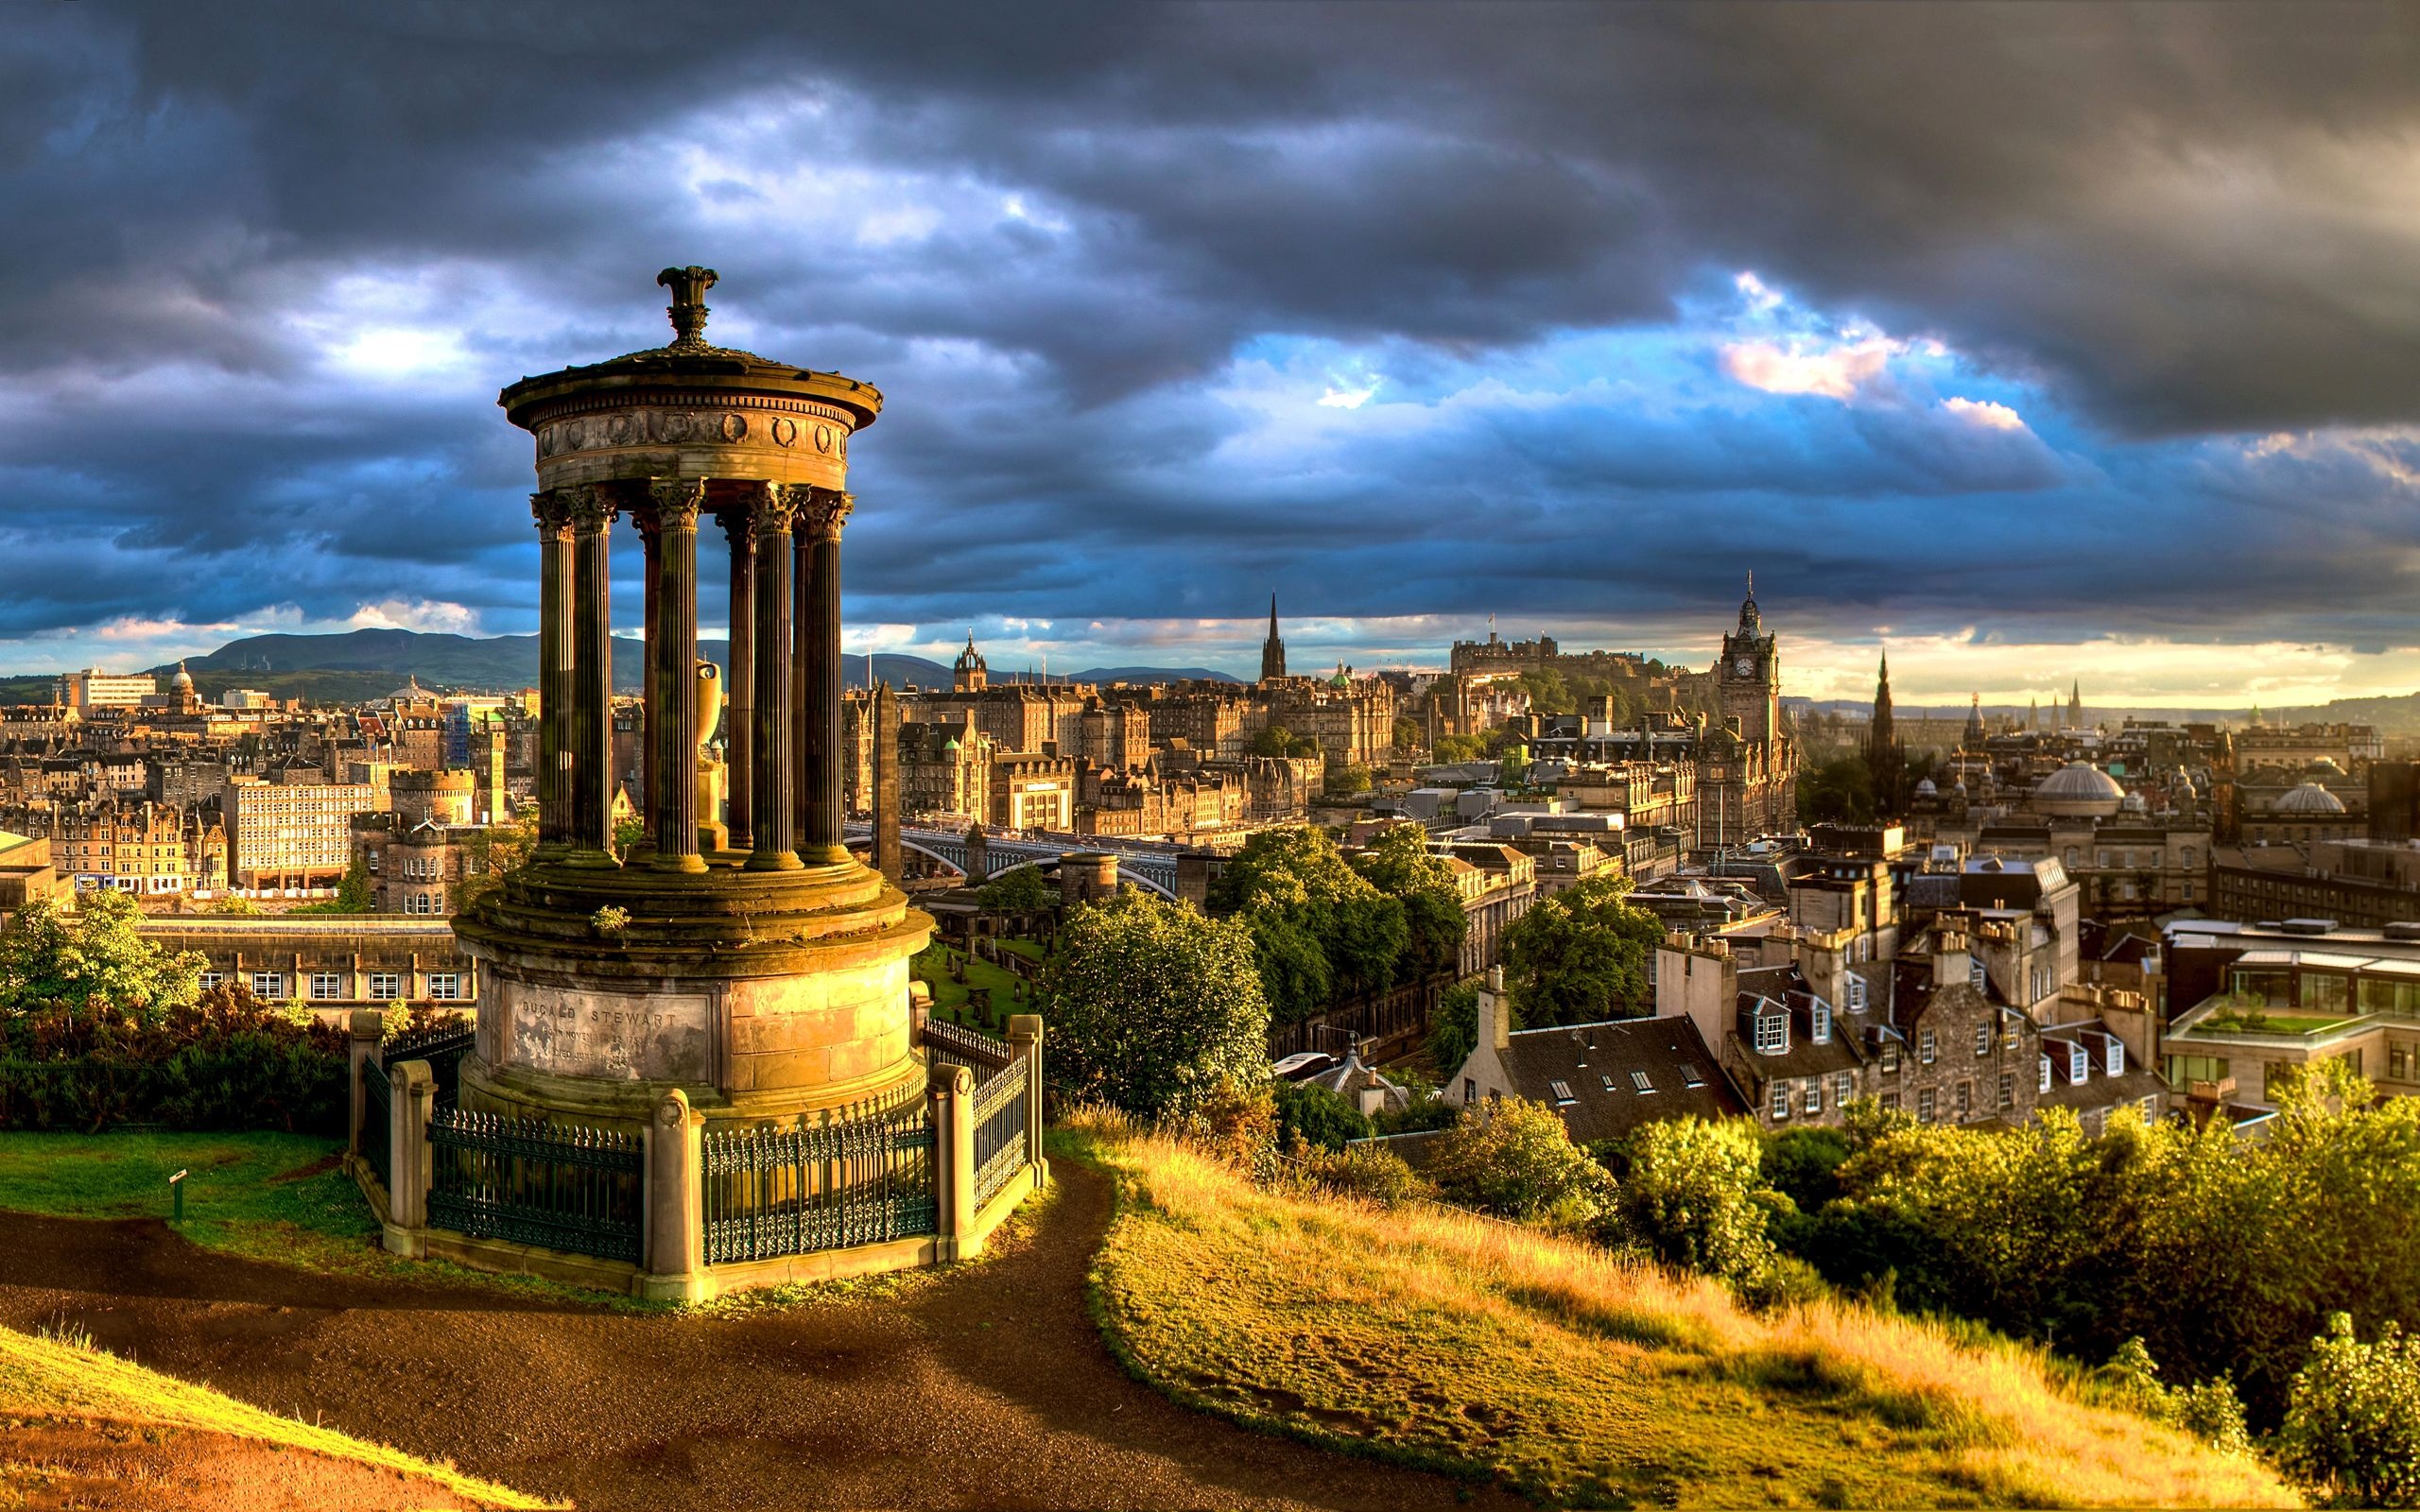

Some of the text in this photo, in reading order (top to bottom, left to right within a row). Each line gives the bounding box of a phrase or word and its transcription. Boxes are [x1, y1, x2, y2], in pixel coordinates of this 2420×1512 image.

[523, 1002, 676, 1026] DUGALD STEWART
[544, 1026, 564, 1038] BON
